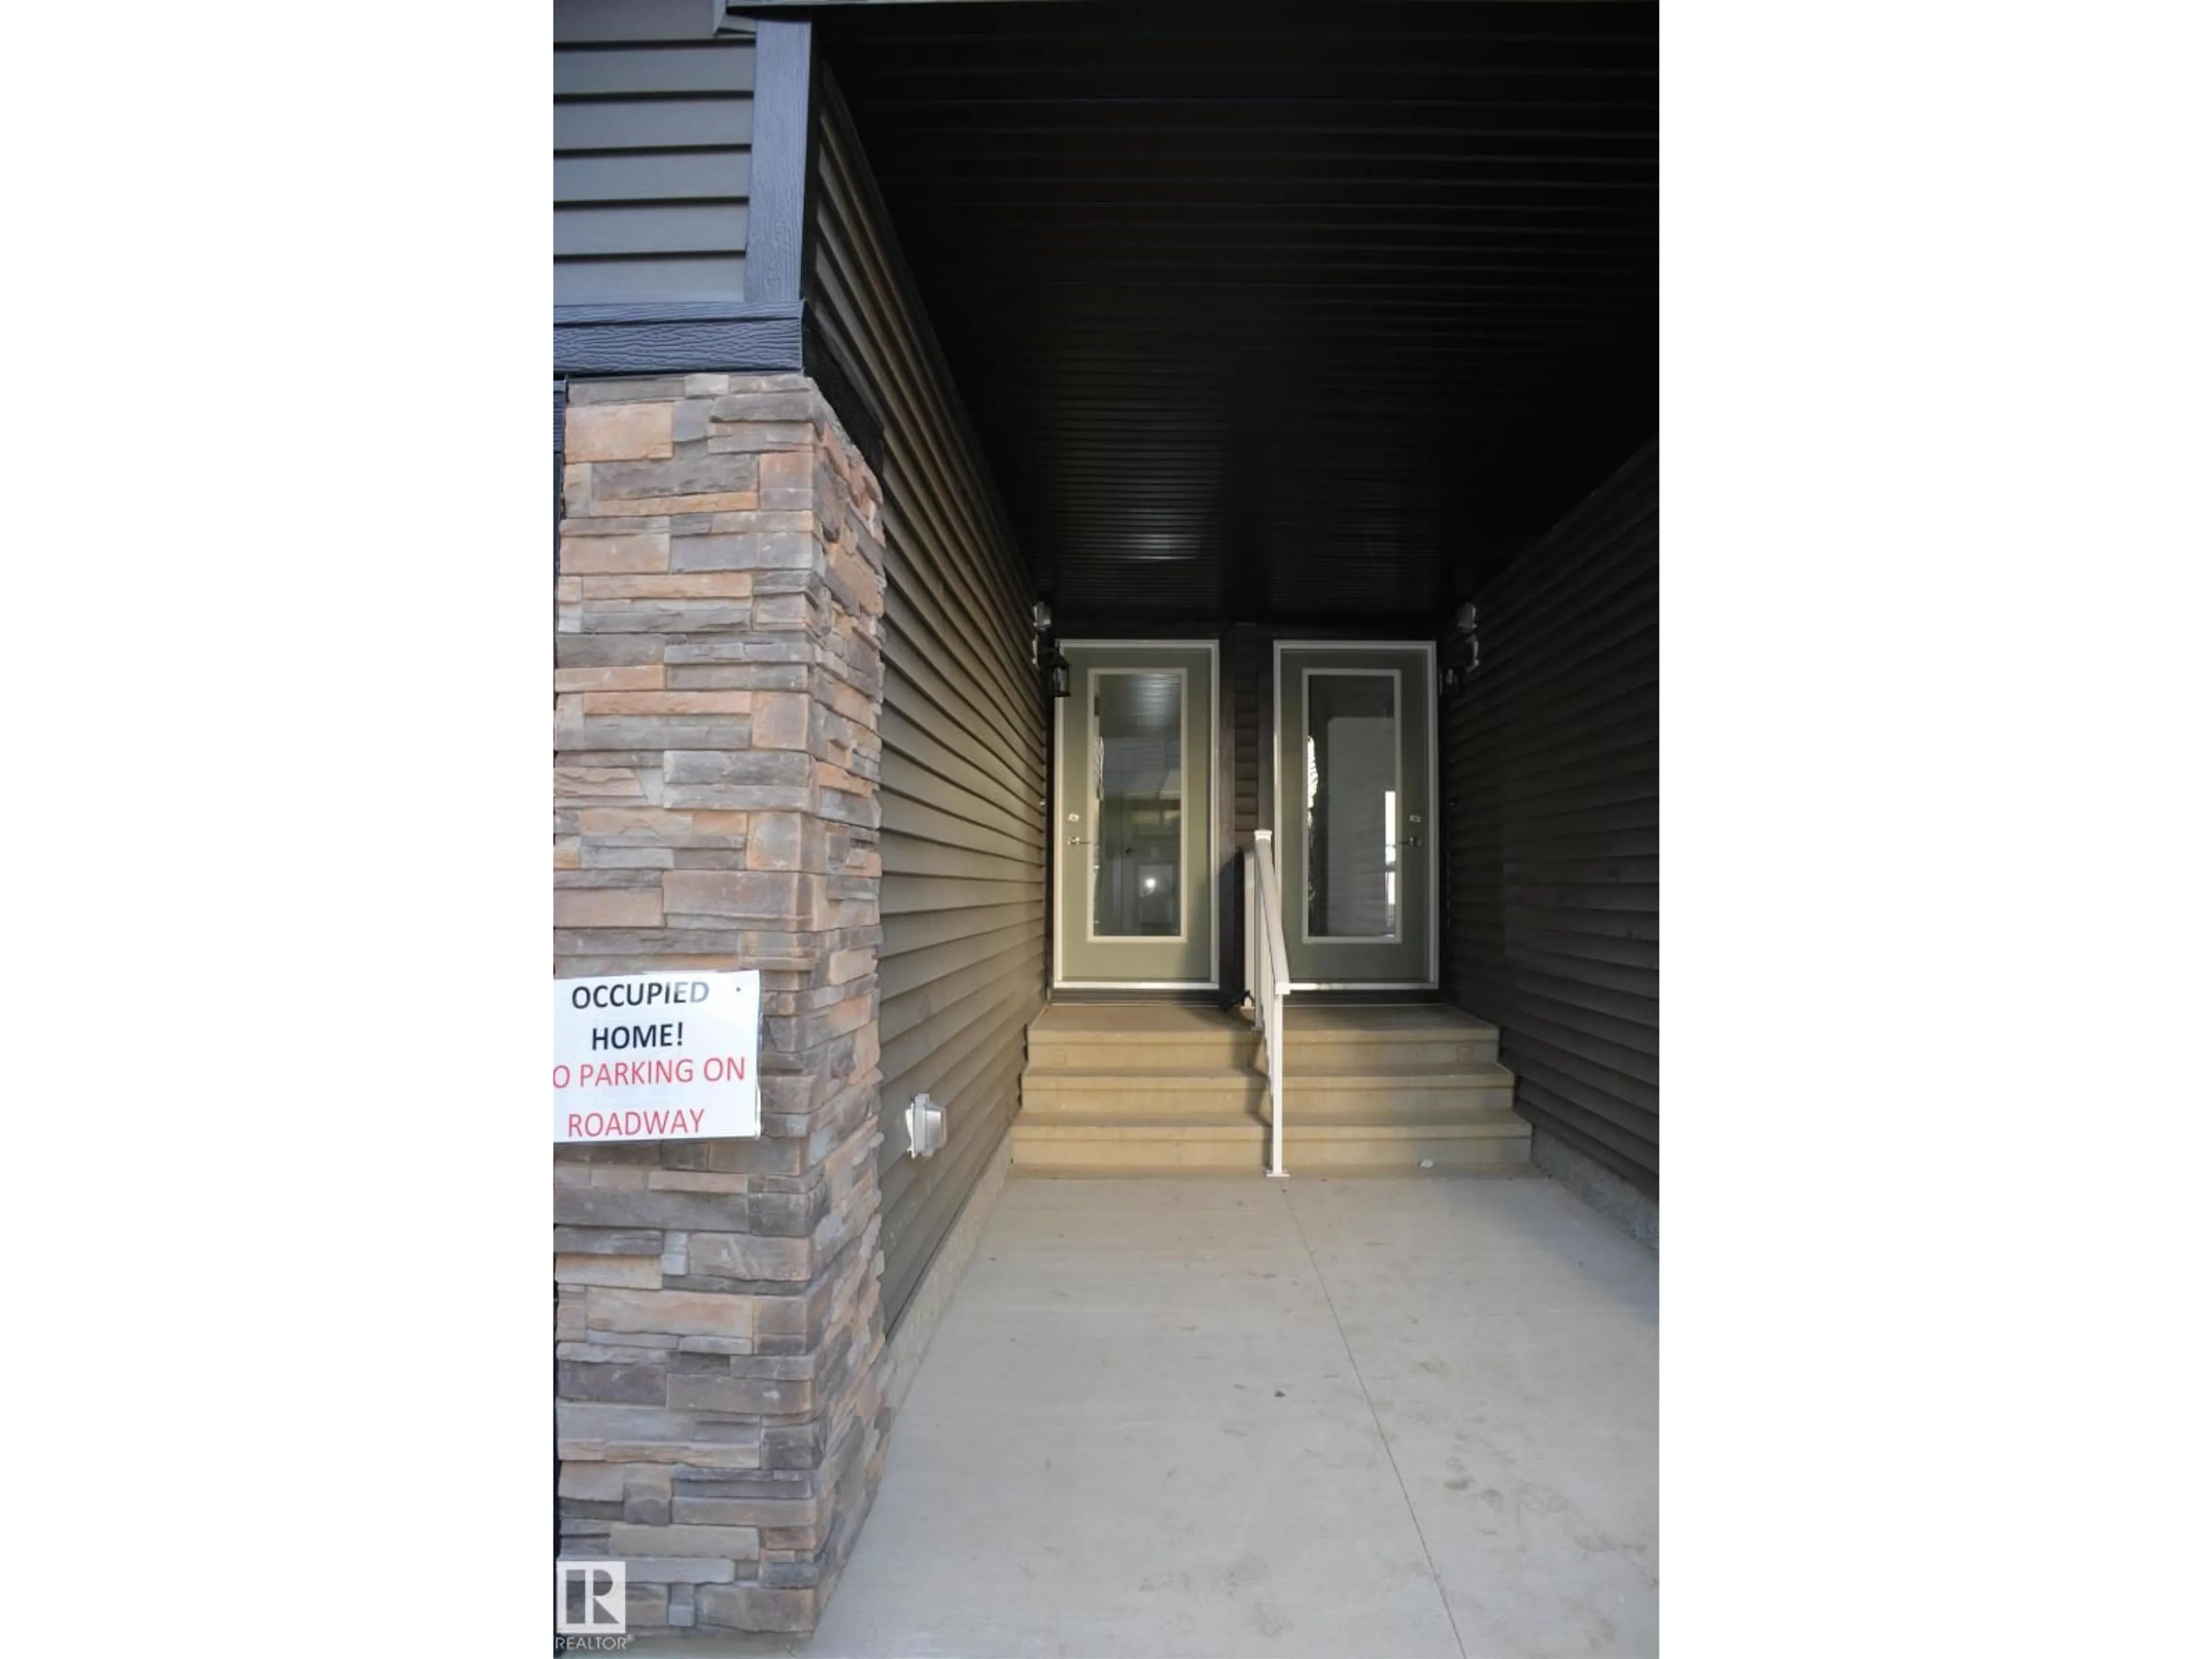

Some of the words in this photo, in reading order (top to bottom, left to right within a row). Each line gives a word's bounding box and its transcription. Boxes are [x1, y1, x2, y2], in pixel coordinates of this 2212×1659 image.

[572, 981, 709, 1009] OCCUPIED
[592, 1022, 683, 1050] HOME!
[553, 1065, 570, 1089] O
[580, 1059, 694, 1087] PARKING
[704, 1056, 745, 1082] ON
[568, 1108, 704, 1138] ROADWAY
